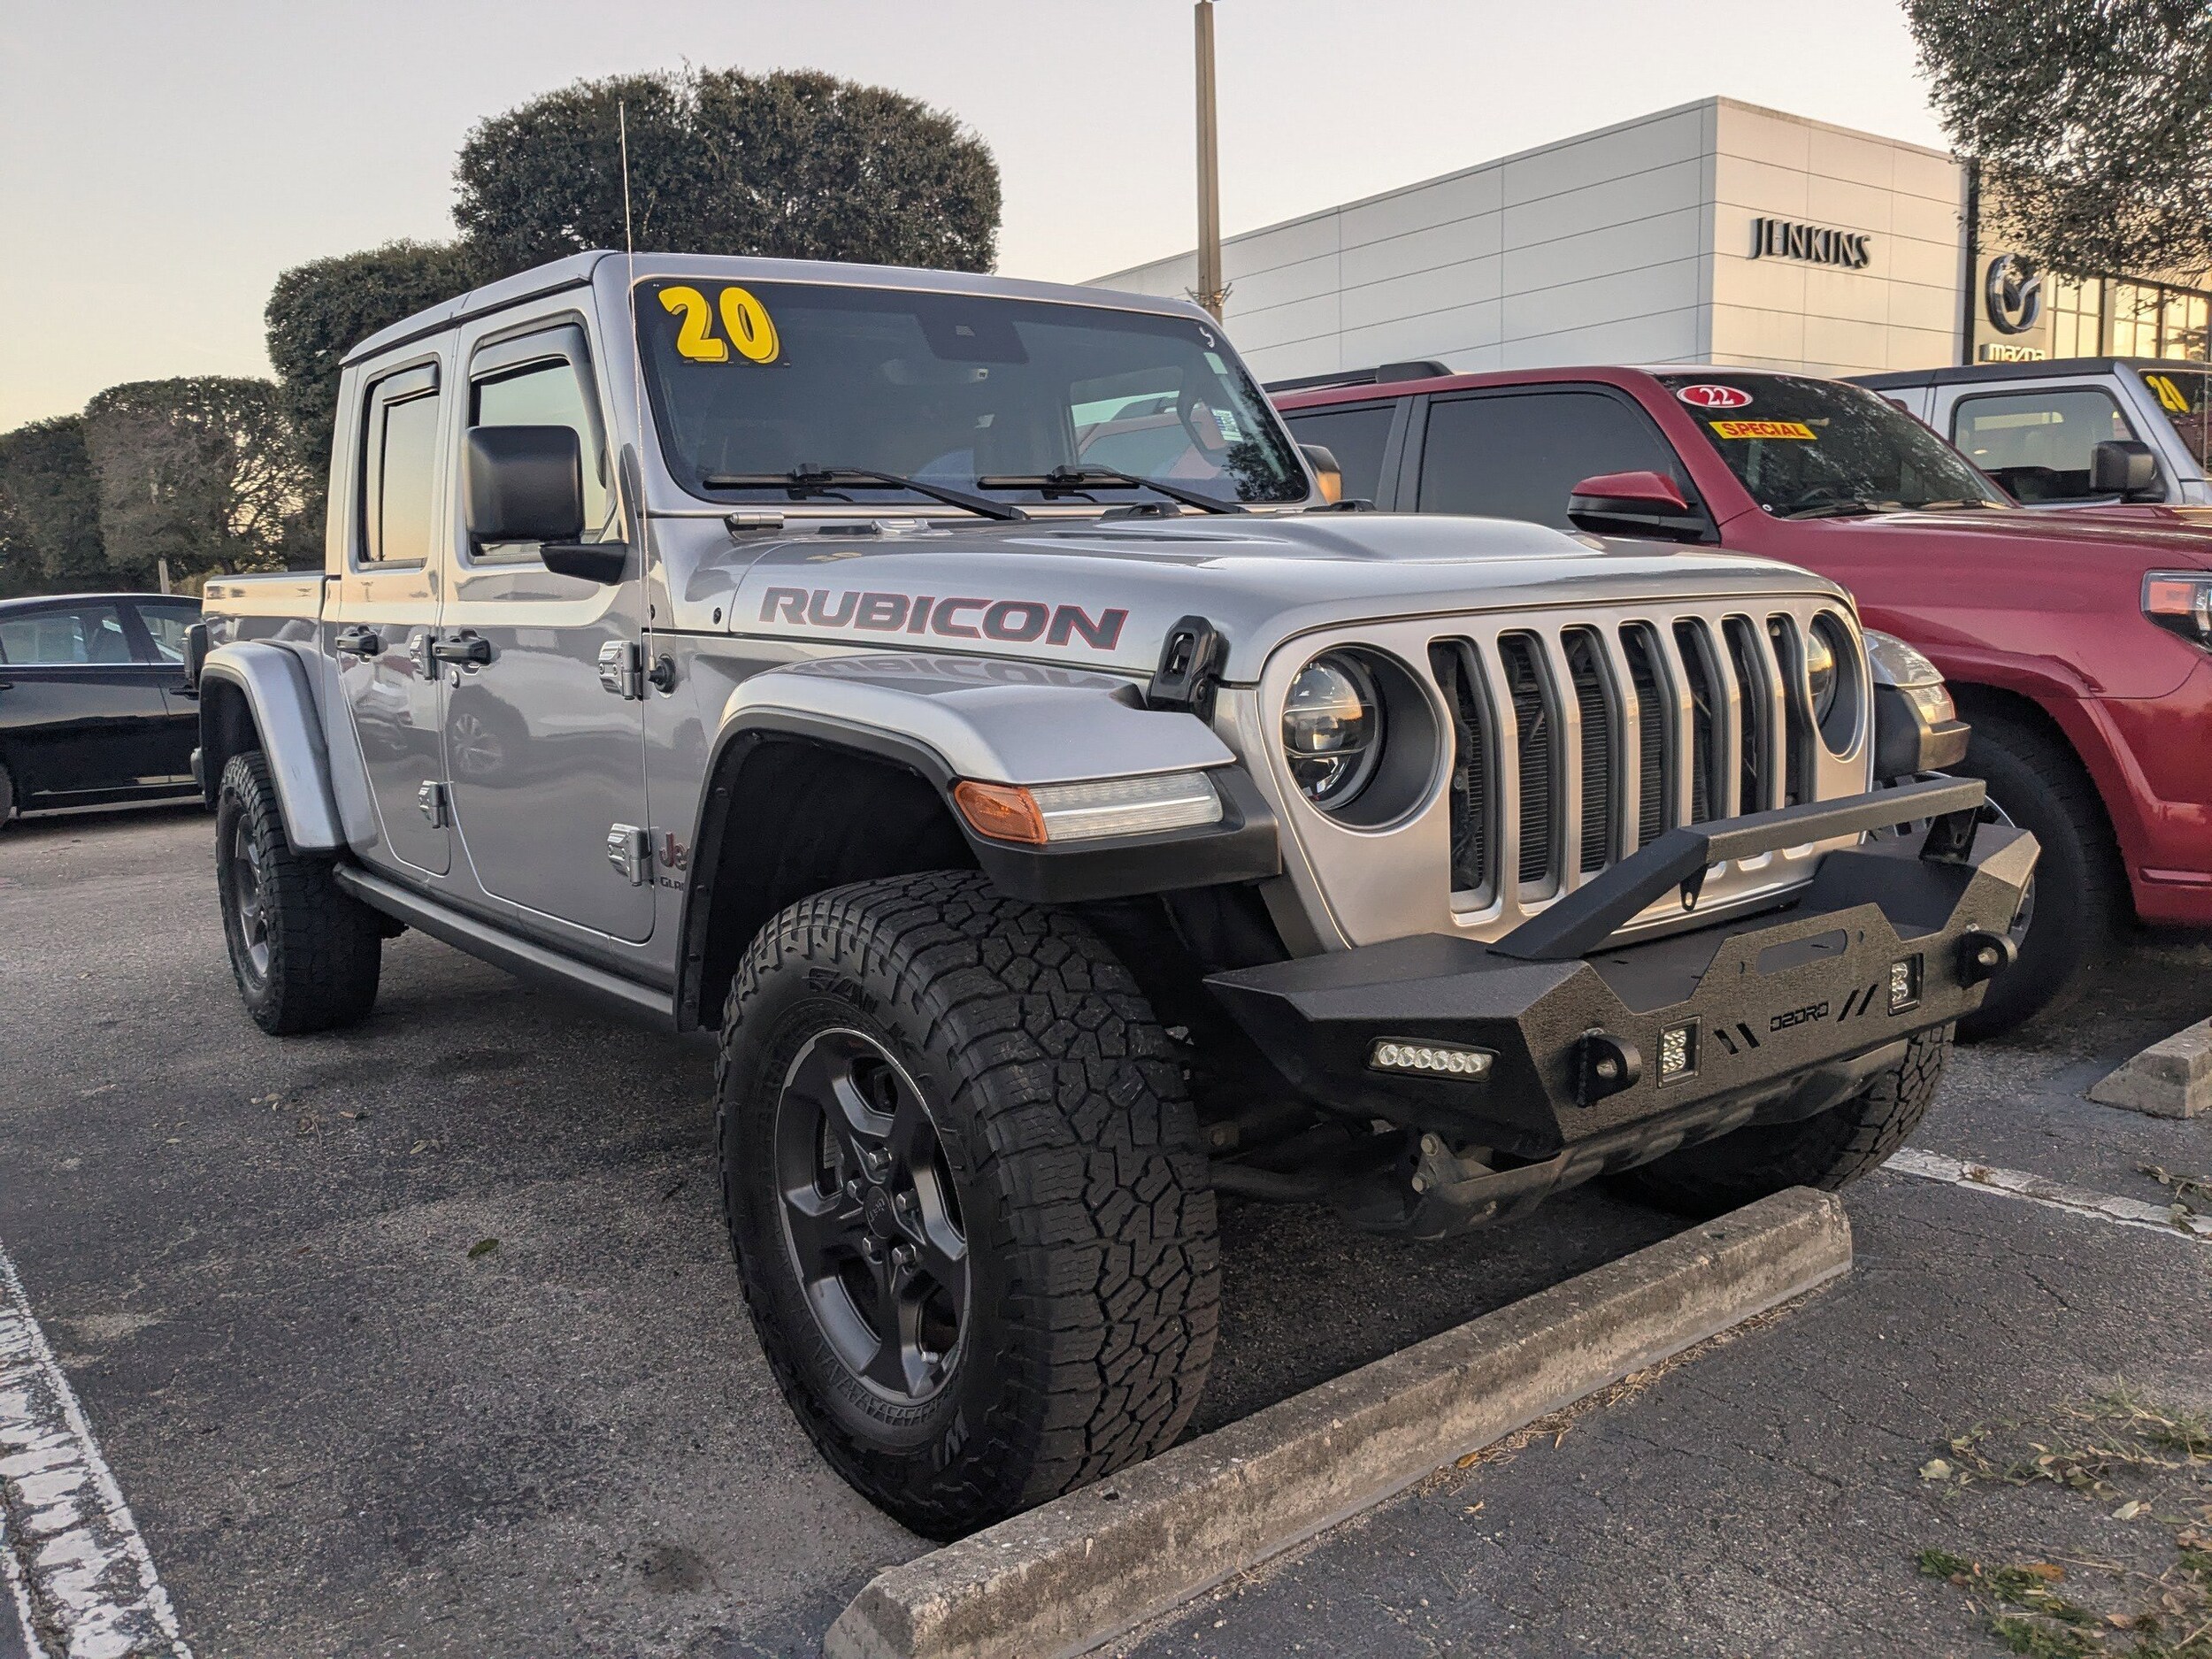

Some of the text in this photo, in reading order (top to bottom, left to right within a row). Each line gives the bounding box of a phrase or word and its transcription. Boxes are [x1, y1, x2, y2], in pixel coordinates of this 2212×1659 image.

[1747, 217, 1871, 270] JENKINS
[657, 286, 780, 364] 20
[1988, 342, 2047, 362] mazda
[1699, 388, 1735, 406] 22
[2146, 375, 2190, 414] 20
[1721, 422, 1809, 437] SPECIAL
[758, 587, 1130, 650] RUBICON
